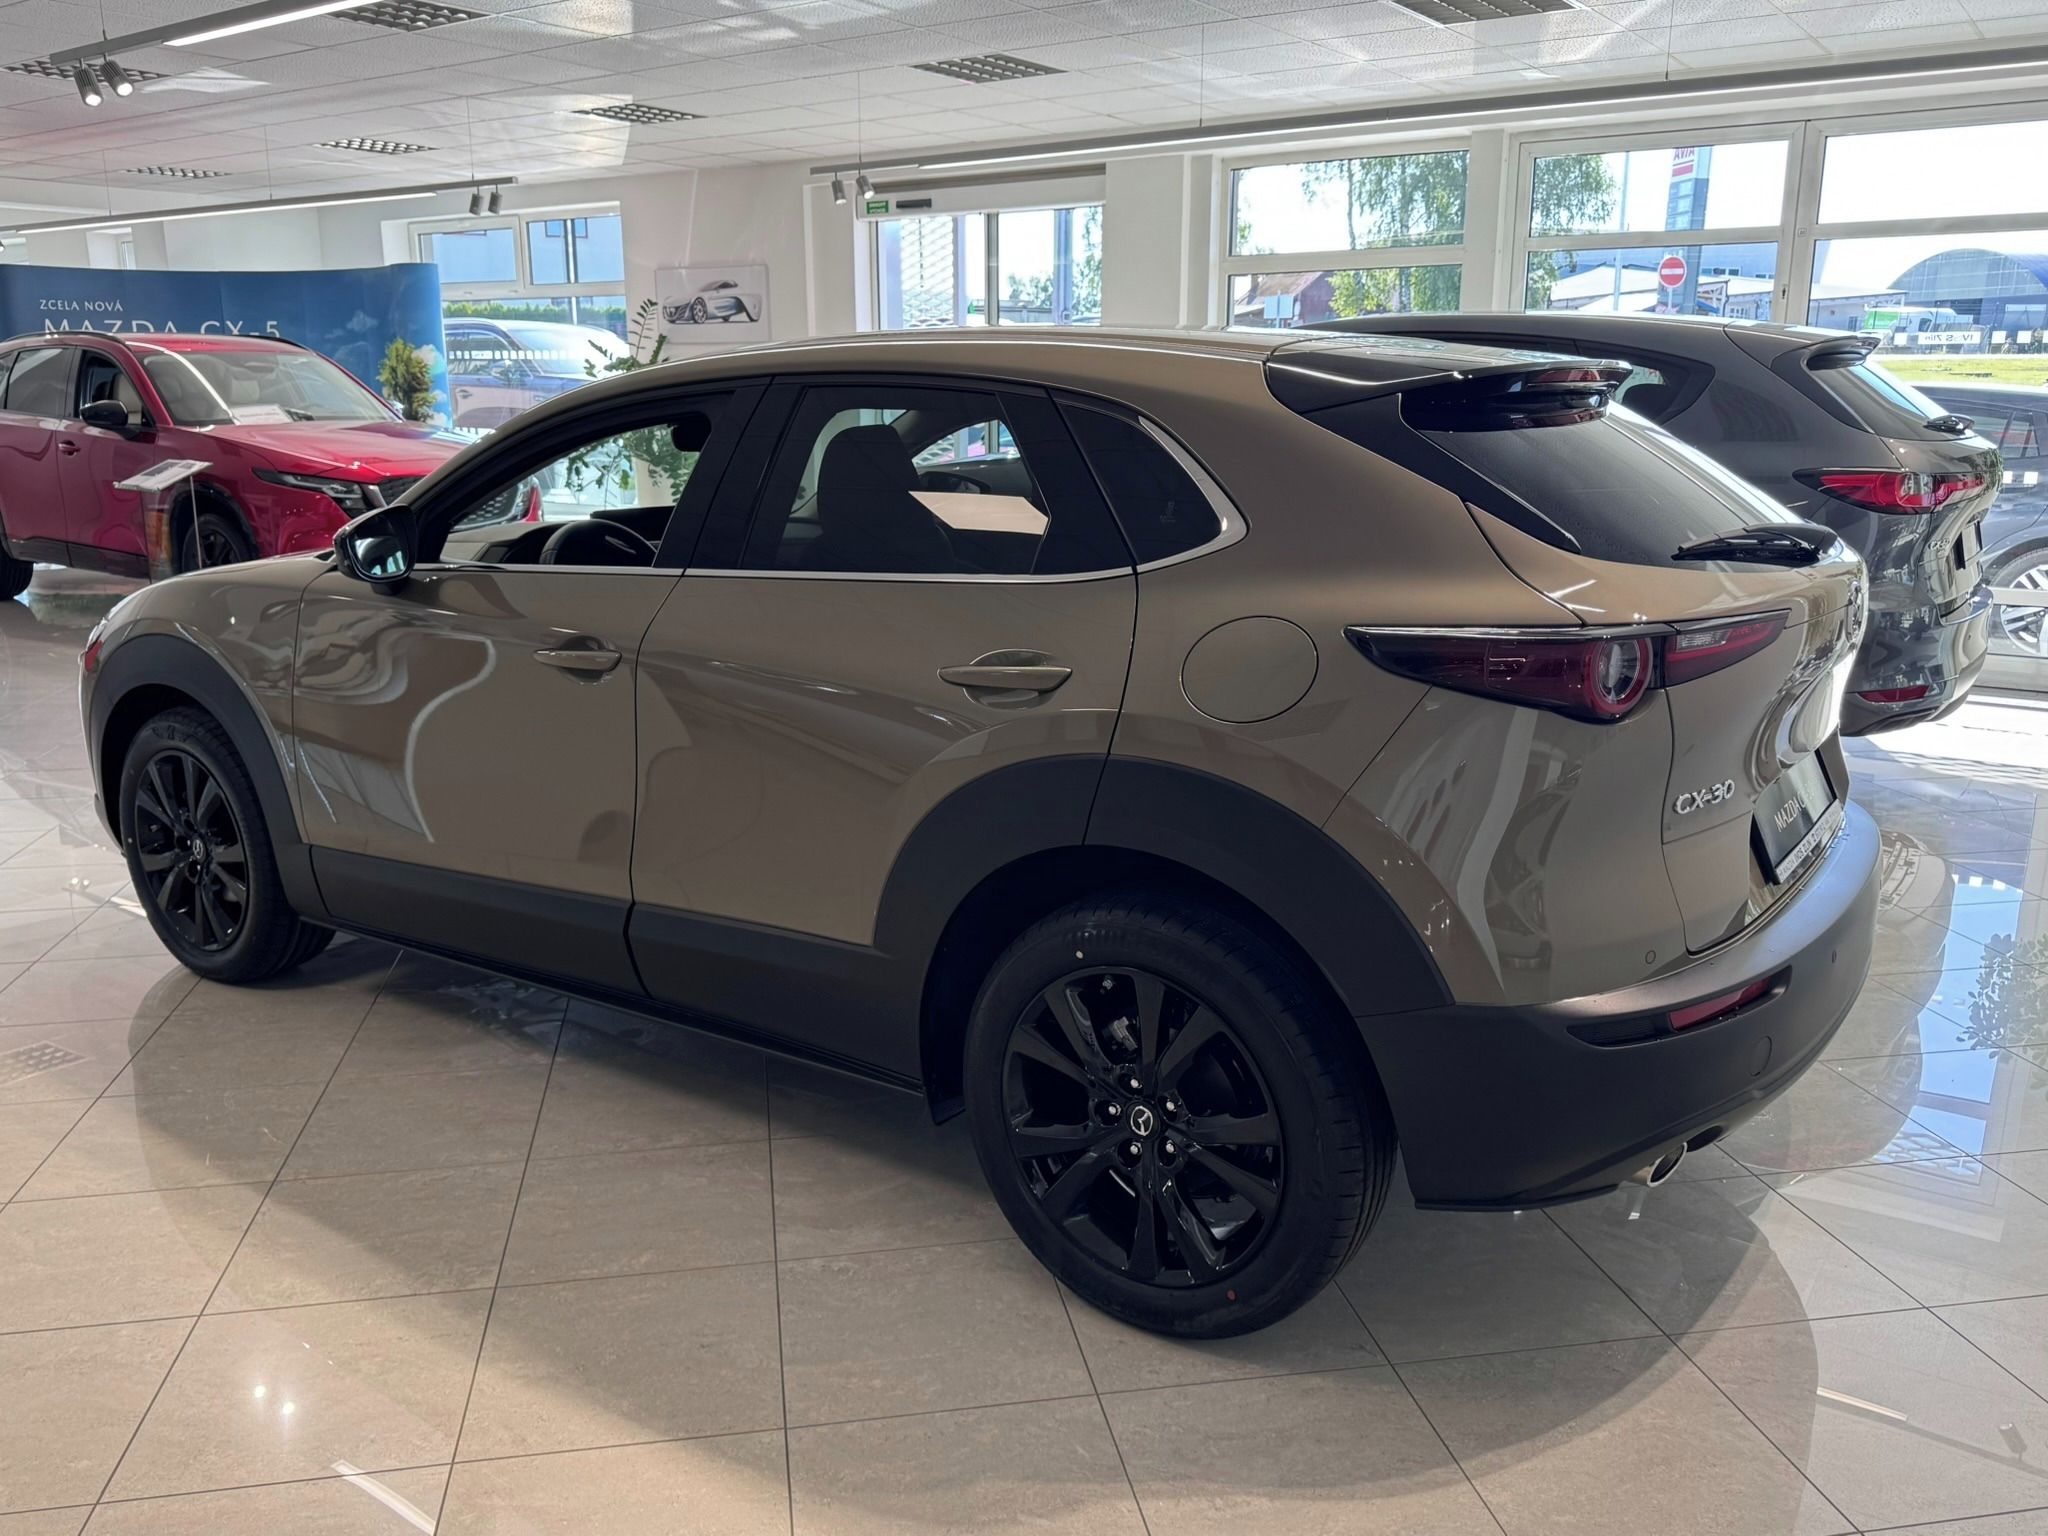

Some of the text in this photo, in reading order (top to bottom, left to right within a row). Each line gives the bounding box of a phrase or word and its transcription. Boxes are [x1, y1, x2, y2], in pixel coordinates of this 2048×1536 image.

[40, 299, 123, 312] ZCELA NOVÁ
[1674, 779, 1736, 815] CX-30
[1774, 796, 1802, 833] MAZDA
